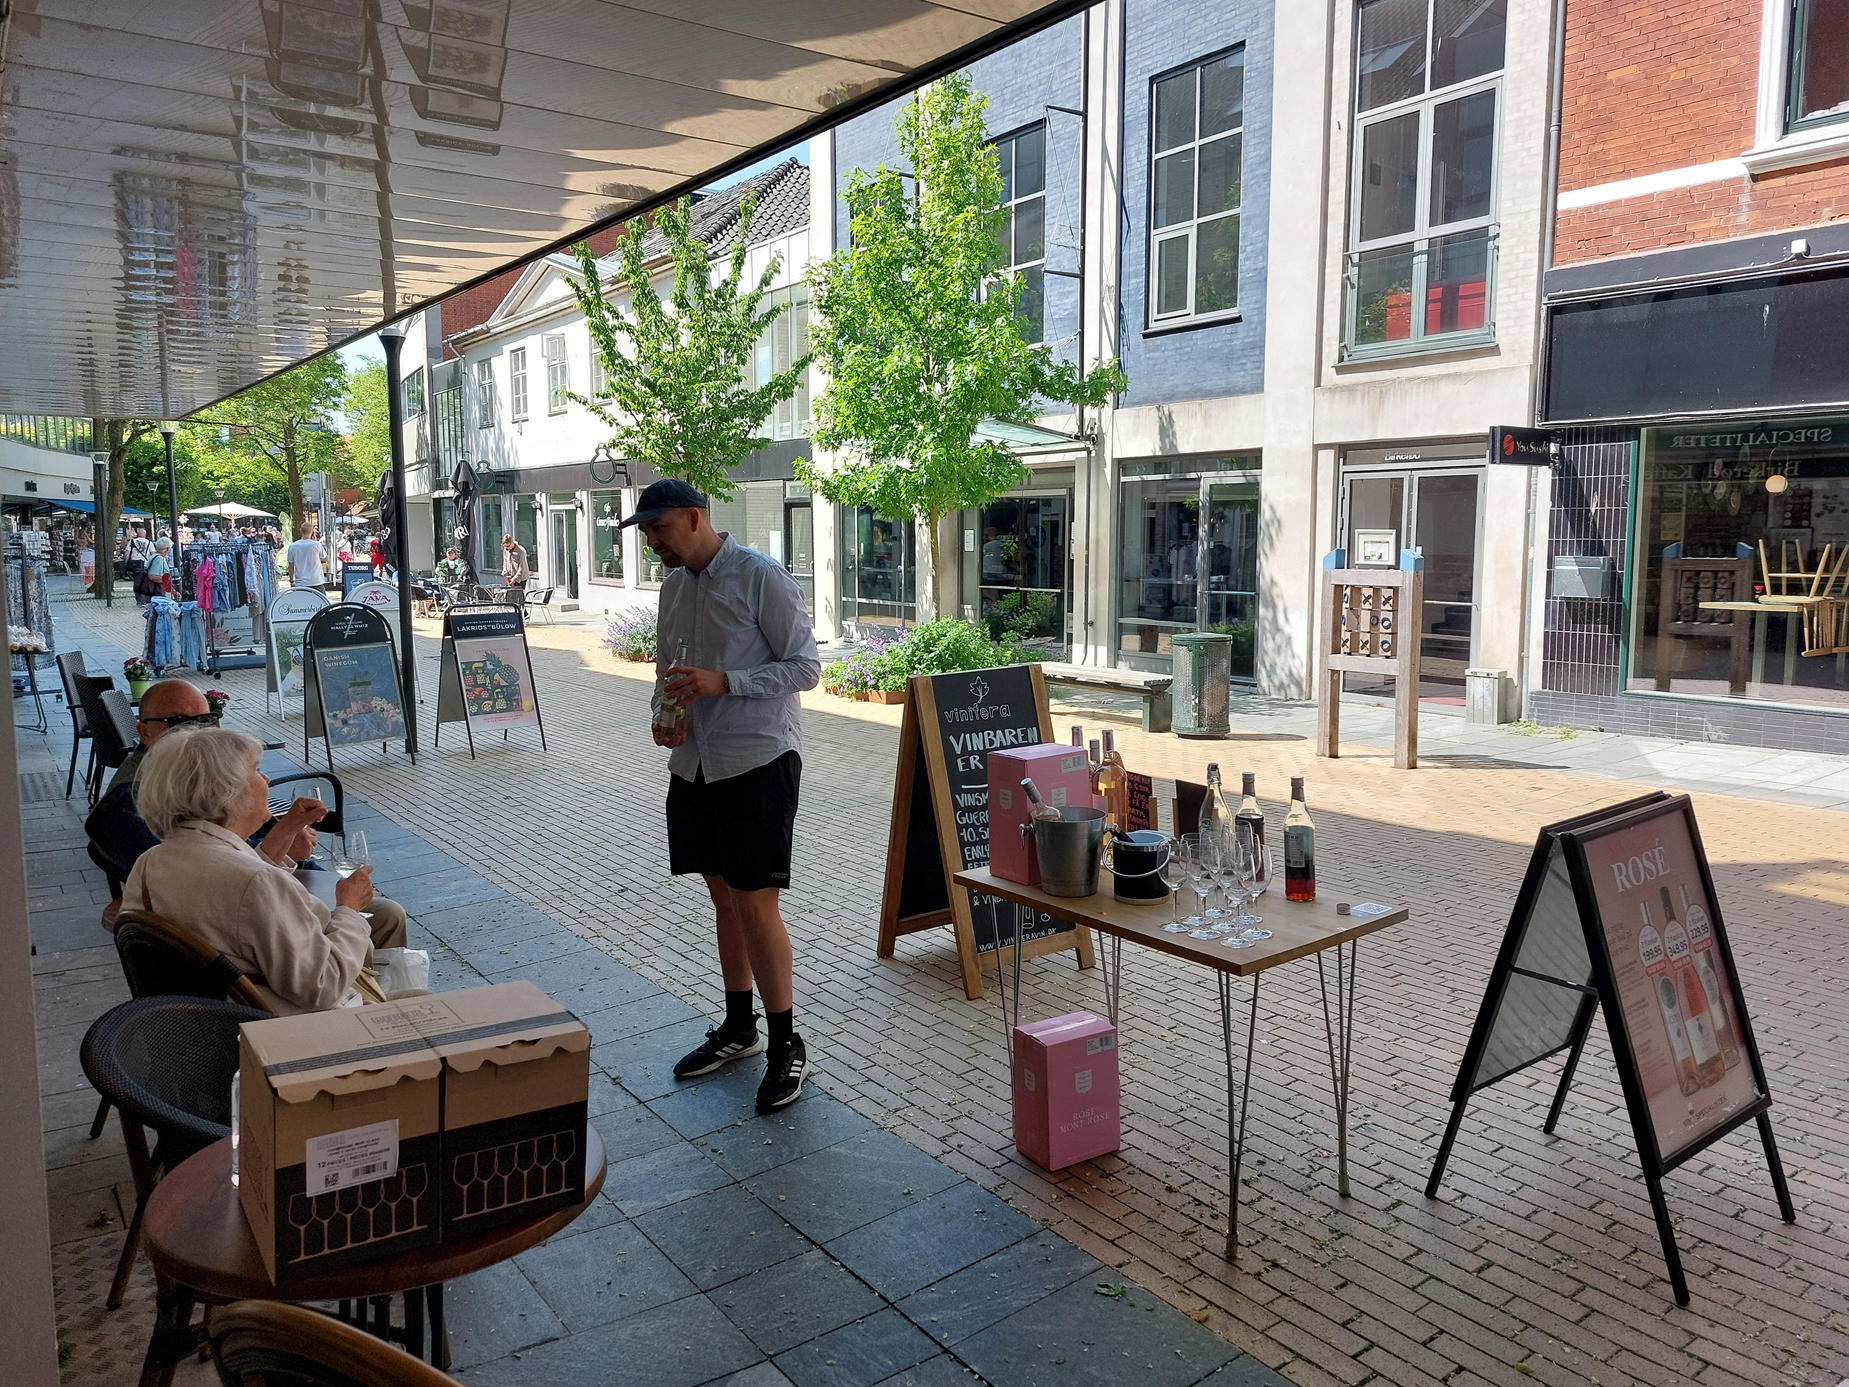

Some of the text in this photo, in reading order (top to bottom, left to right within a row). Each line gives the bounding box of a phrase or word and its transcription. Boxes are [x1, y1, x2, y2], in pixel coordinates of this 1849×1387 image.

[1516, 441, 1549, 453] You Sushi
[362, 595, 391, 603] JAVA
[325, 660, 358, 668] WINEGUM
[944, 703, 1011, 723] vinifera
[949, 727, 1039, 754] VINBAREN
[957, 754, 984, 772] ER
[960, 827, 980, 842] 10.
[1611, 838, 1670, 893] ROSÉ
[1643, 945, 1662, 961] 199,95
[1668, 940, 1688, 957] 349,95
[1060, 1111, 1110, 1133] MONT ROSE
[317, 1161, 327, 1169] 12
